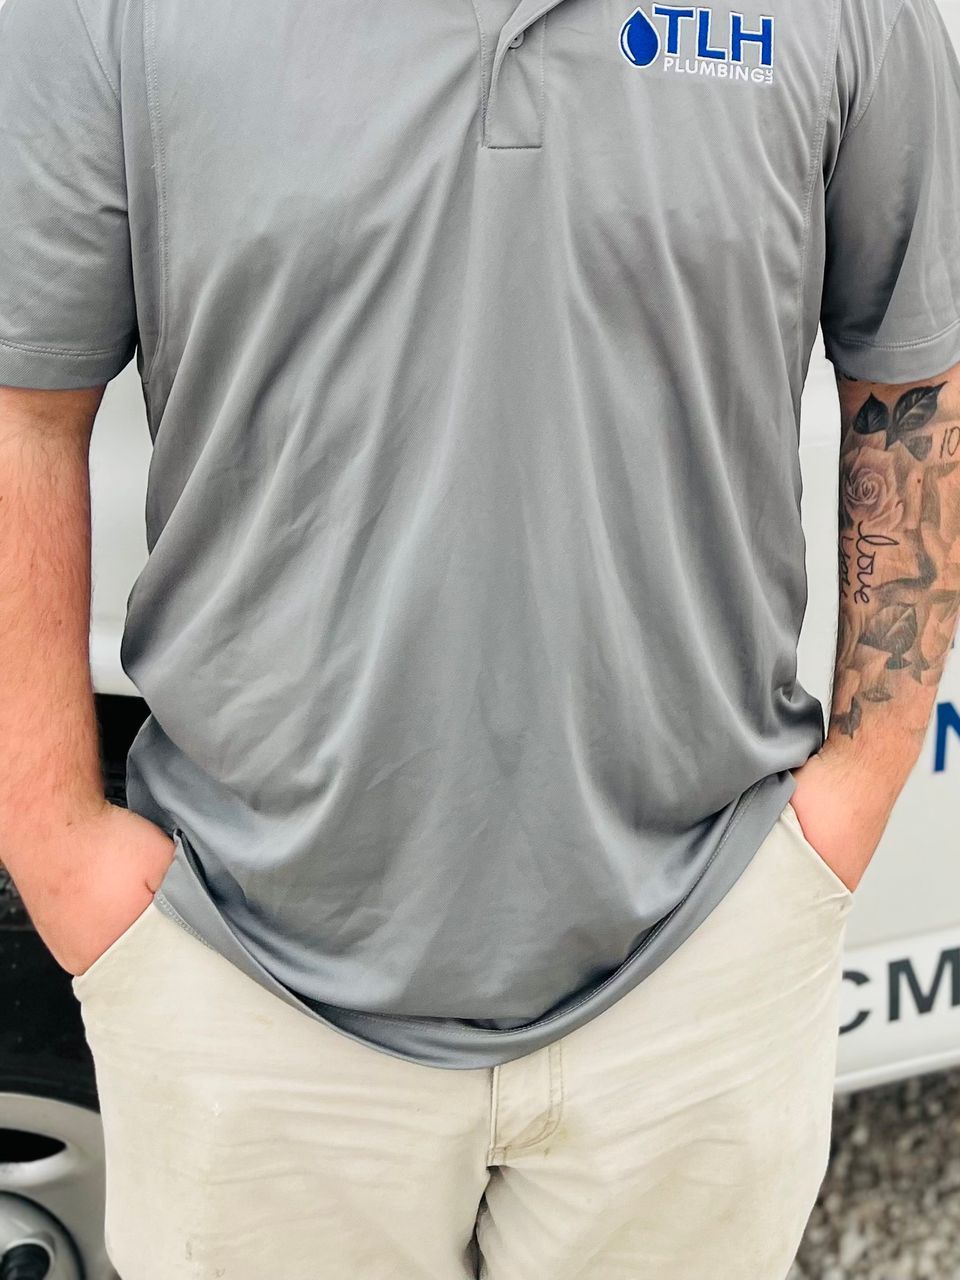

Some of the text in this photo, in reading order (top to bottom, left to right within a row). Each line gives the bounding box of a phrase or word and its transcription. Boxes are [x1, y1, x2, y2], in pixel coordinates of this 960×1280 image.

[652, 3, 774, 69] TLH
[664, 58, 764, 84] PLUMBING
[854, 520, 899, 604] love
